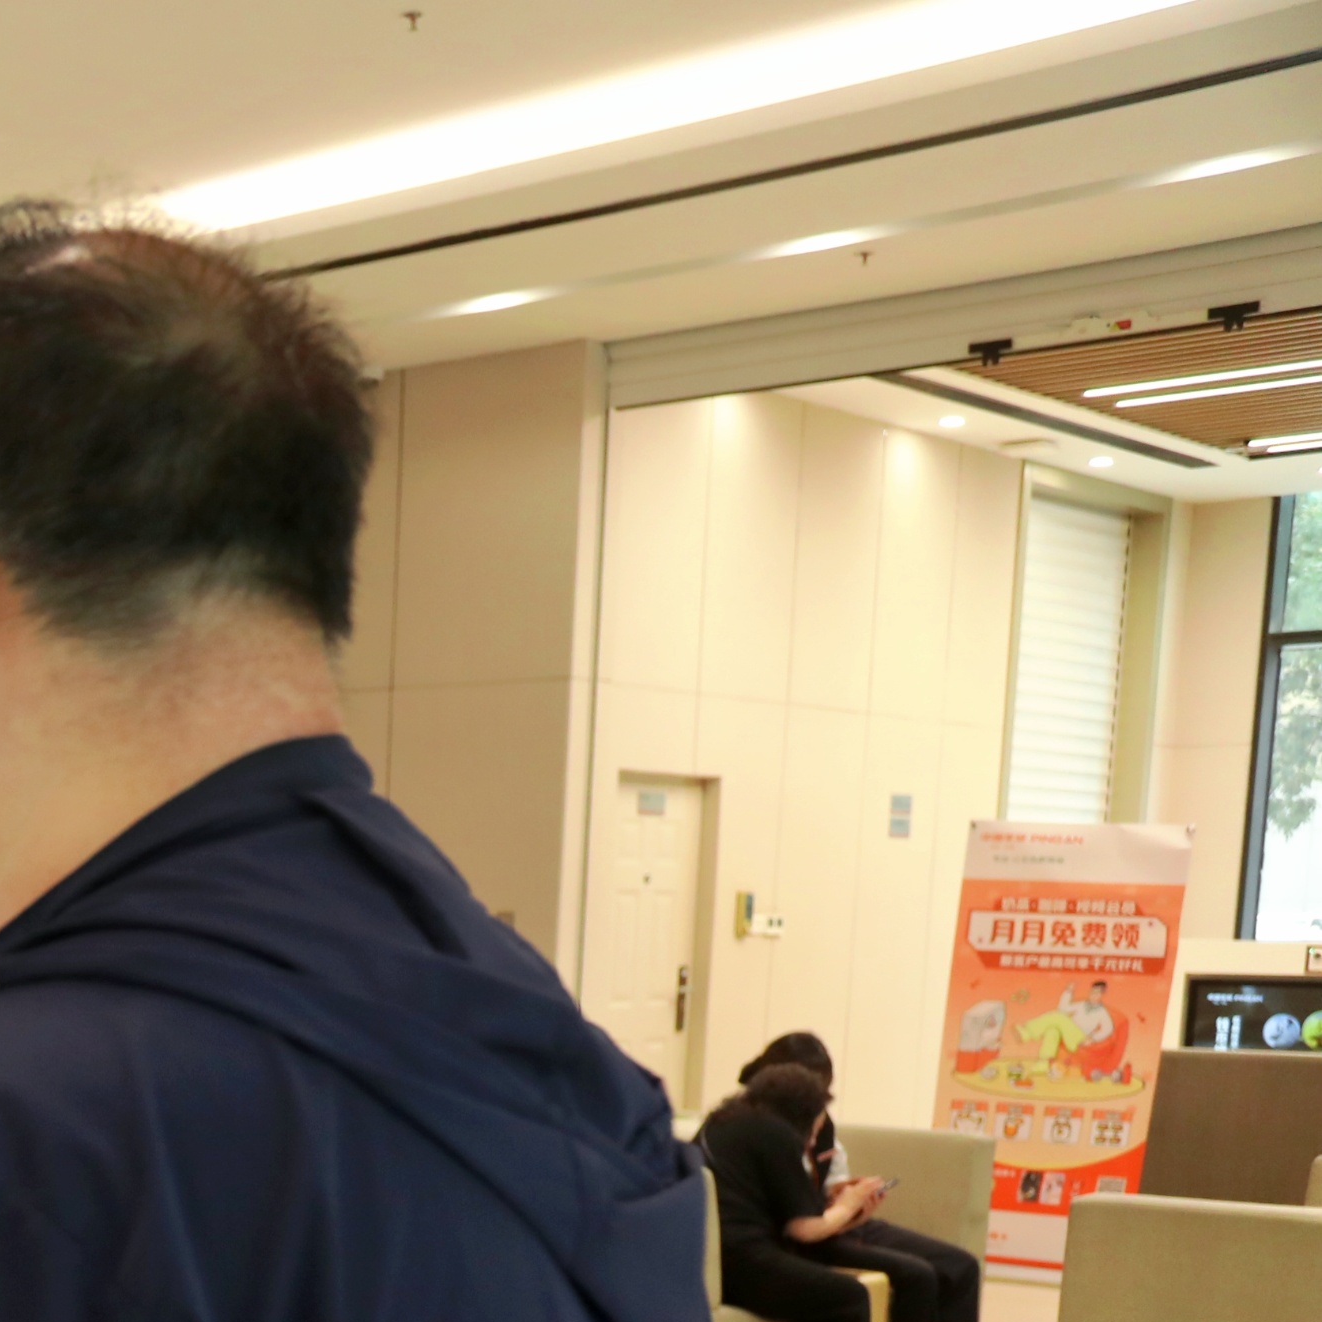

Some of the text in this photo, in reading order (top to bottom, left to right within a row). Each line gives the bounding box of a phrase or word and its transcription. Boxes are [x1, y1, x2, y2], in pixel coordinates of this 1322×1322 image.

[990, 918, 1141, 949] 月月免费领
